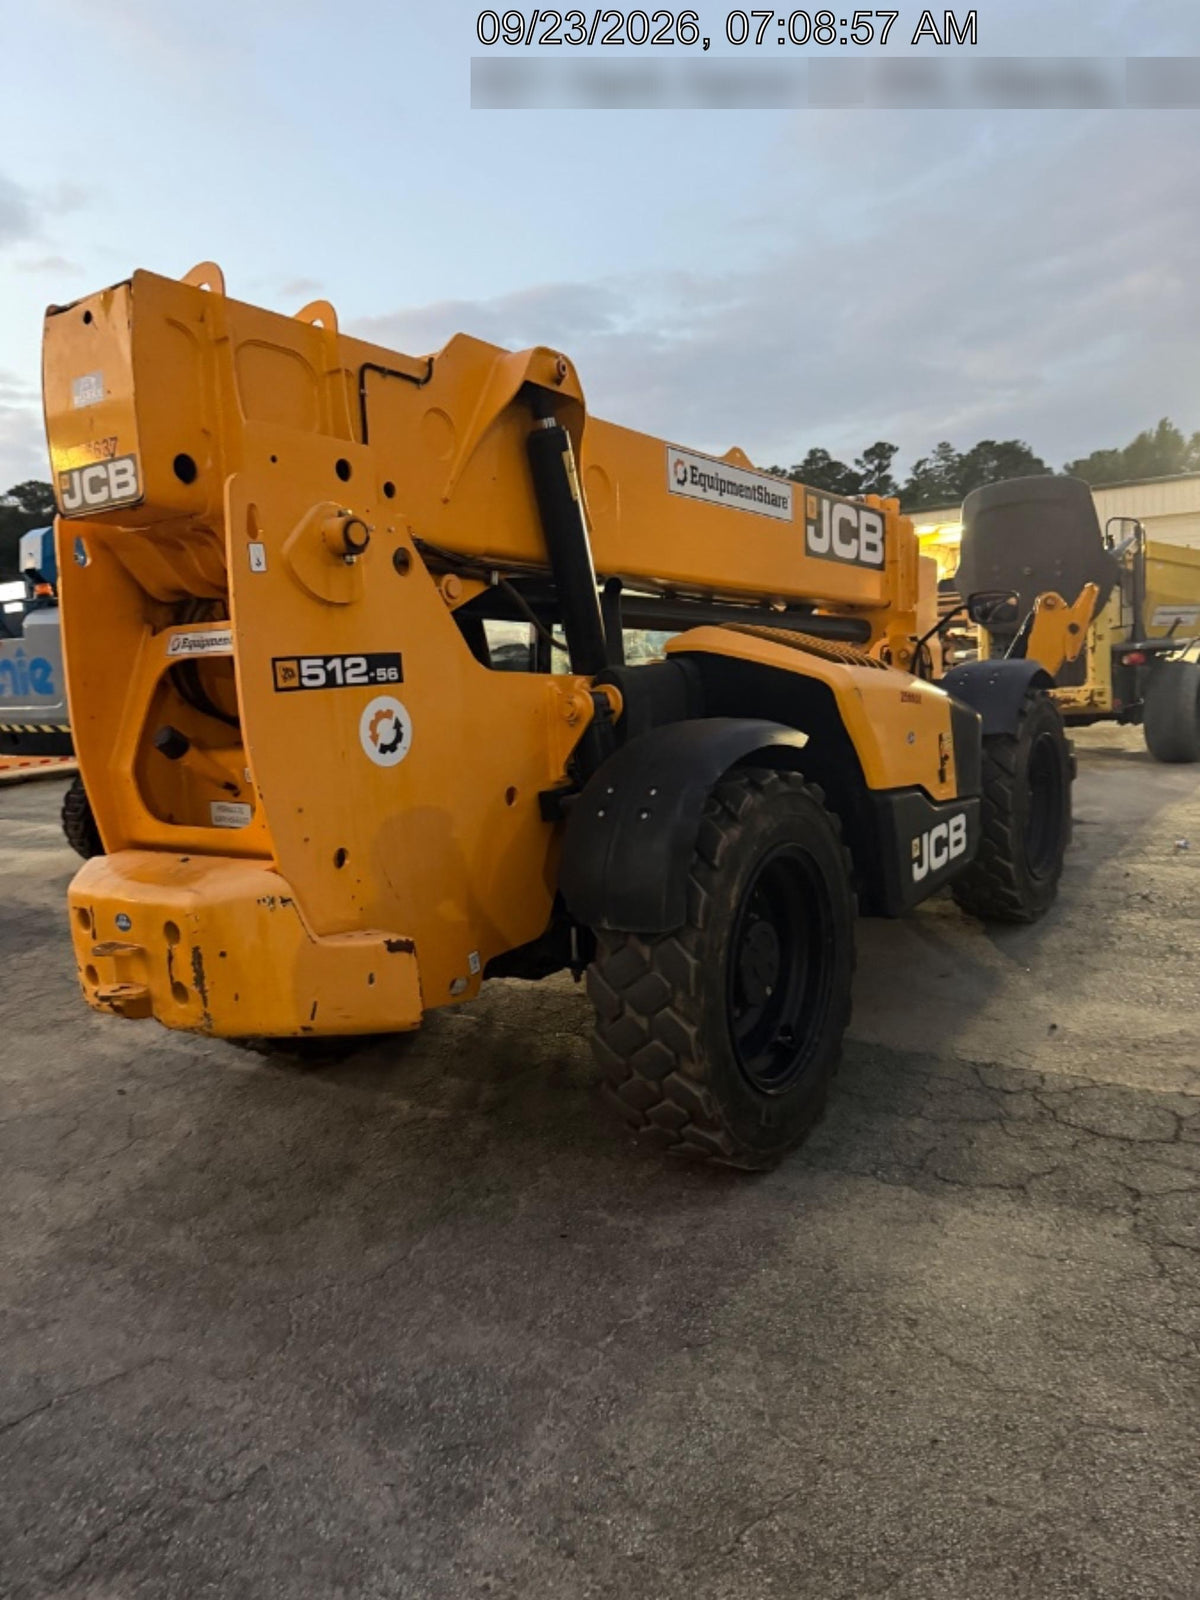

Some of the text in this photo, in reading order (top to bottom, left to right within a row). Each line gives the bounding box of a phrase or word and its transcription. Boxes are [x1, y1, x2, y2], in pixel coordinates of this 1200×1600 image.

[62, 458, 138, 509] JCB
[690, 465, 789, 510] EquipmentShare
[806, 499, 885, 565] JCB
[911, 812, 967, 882] JCB
